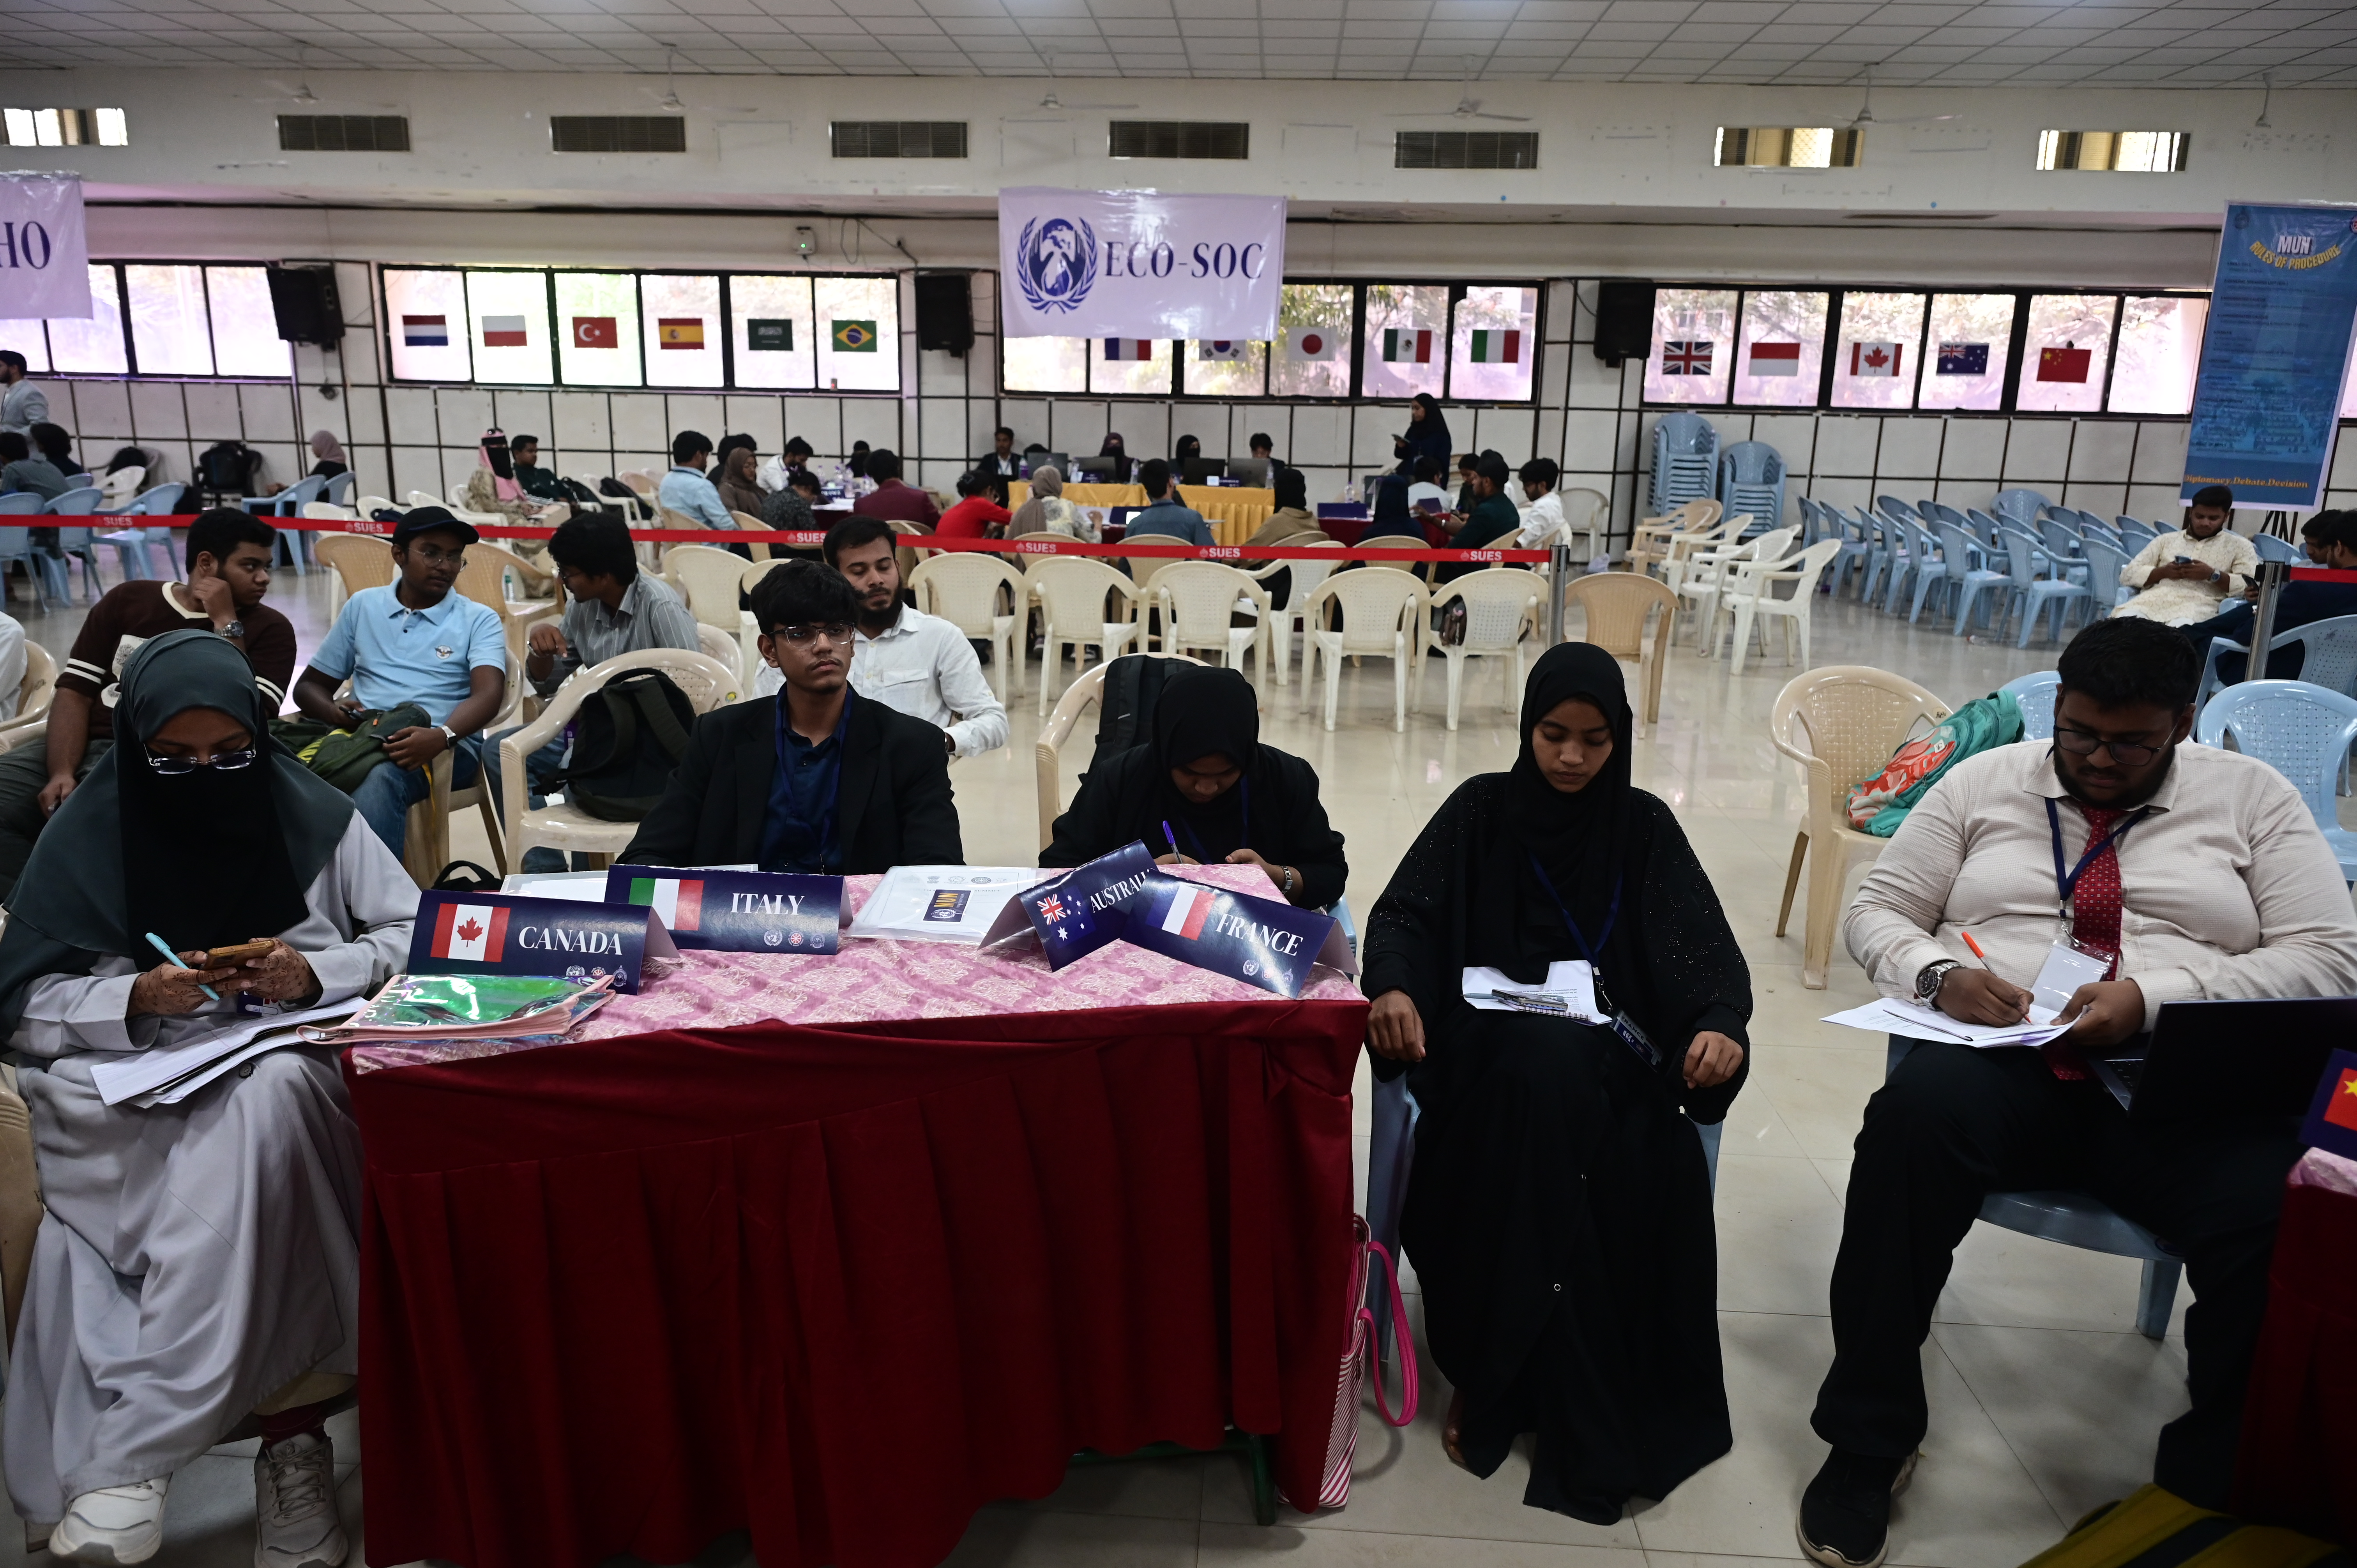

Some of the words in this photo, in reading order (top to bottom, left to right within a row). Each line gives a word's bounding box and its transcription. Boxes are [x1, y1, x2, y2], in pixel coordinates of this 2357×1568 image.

[2277, 235, 2311, 254] MUN
[1105, 241, 1263, 279] ECO-SOC
[2249, 241, 2276, 264] RULES
[2275, 256, 2288, 268] OF
[2288, 244, 2341, 270] PROCEDURE
[103, 516, 133, 526] SUES
[354, 522, 384, 532] SUES
[797, 532, 826, 542] SUES
[1025, 542, 1057, 553] SUES
[1209, 547, 1240, 558] SUES
[1470, 551, 1502, 561] SUES
[1090, 869, 1150, 913] AUSTRAL
[731, 893, 805, 915] ITALY
[933, 893, 958, 907] MUN
[518, 926, 622, 955] CANADA
[1216, 914, 1303, 956] FRANCE
